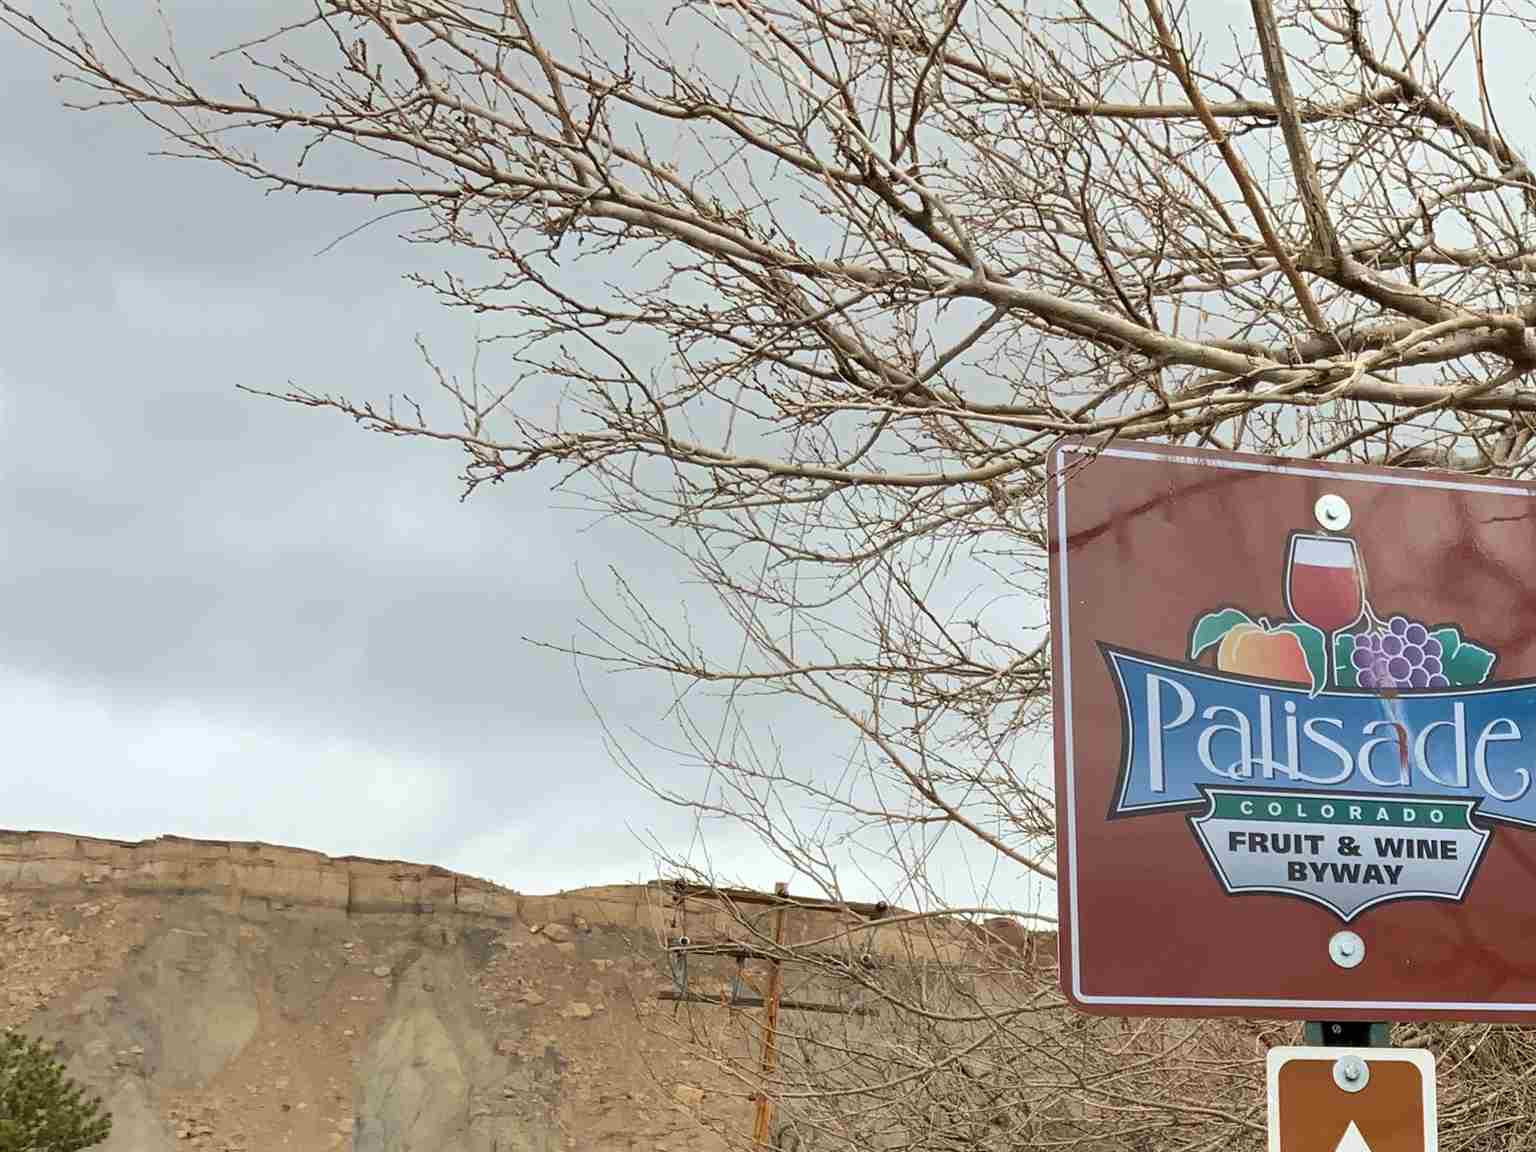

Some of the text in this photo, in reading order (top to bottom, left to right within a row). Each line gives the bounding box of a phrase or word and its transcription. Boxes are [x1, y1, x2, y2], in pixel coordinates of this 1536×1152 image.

[1146, 673, 1531, 800] Palisade
[1240, 801, 1444, 823] COLORADO
[1227, 831, 1459, 860] FRUIT & WINE
[1286, 861, 1404, 885] BYWAY
